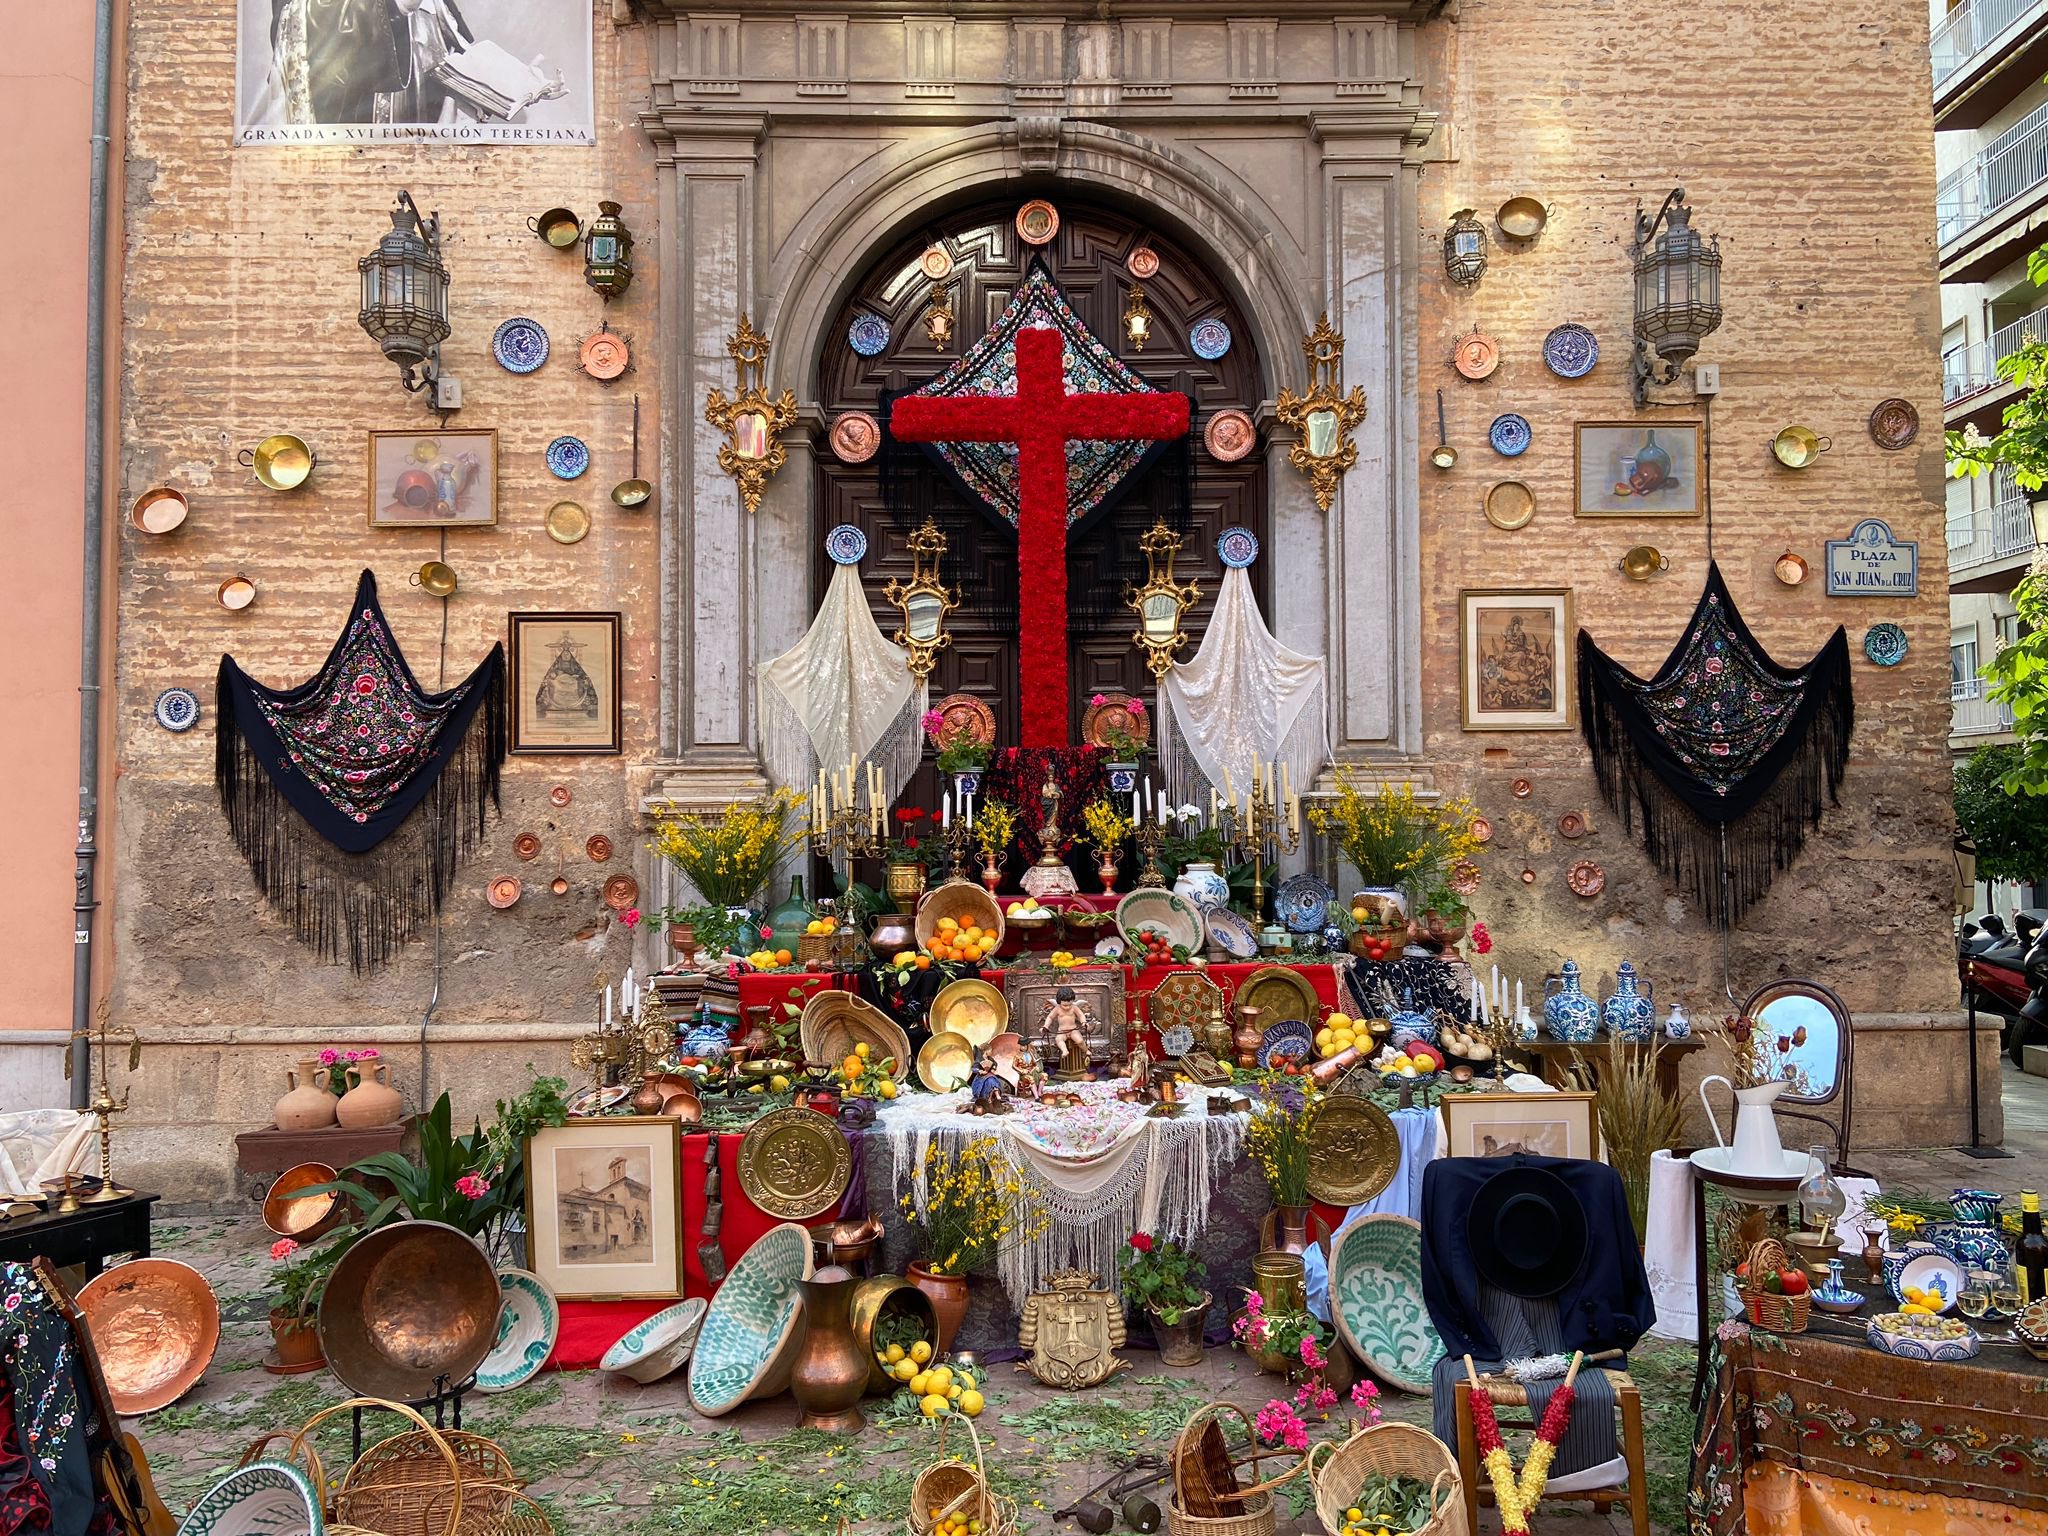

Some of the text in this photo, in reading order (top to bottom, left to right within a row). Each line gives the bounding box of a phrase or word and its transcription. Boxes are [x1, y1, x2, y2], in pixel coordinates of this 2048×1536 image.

[243, 125, 588, 141] GRANADA XVI FUNDACIÓN TERESIANA
[1851, 550, 1896, 561] PLAZA
[1834, 571, 1851, 586] SAN
[1855, 572, 1881, 586] JUAN
[1893, 572, 1911, 586] CRUZ
